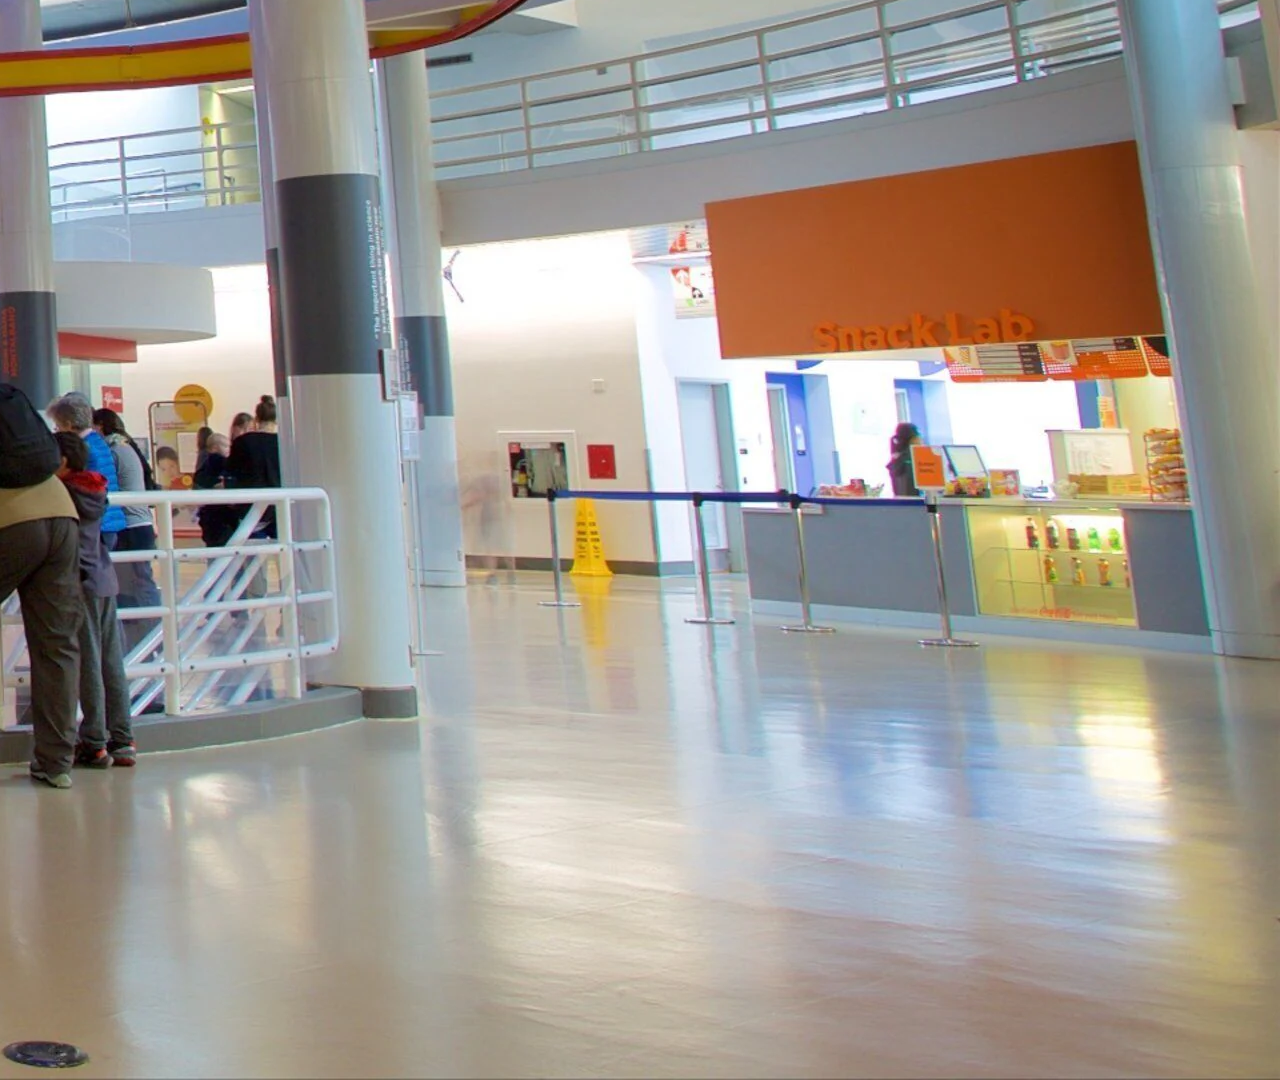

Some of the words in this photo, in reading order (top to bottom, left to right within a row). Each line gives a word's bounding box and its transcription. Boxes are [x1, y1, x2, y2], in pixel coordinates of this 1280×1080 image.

[370, 270, 380, 314] important
[813, 312, 939, 353] Snack
[945, 308, 1035, 345] Lab
